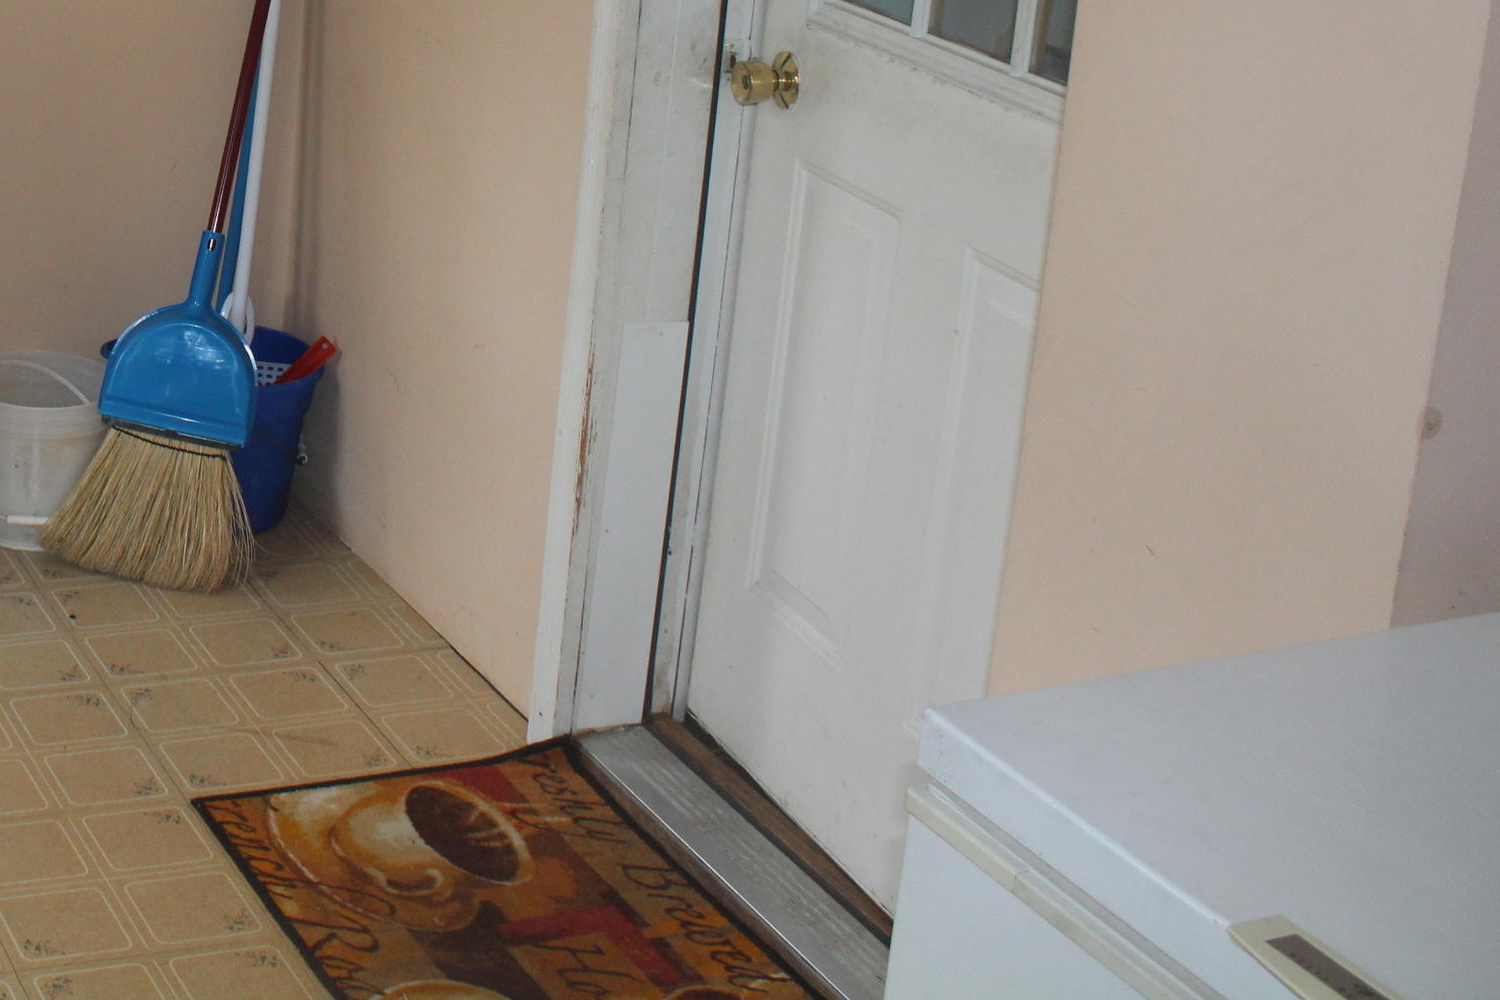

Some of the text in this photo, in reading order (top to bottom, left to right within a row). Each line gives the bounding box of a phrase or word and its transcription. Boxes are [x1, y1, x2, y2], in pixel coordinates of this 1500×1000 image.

[206, 797, 396, 917] rench
[509, 753, 793, 994] reshly Brewed
